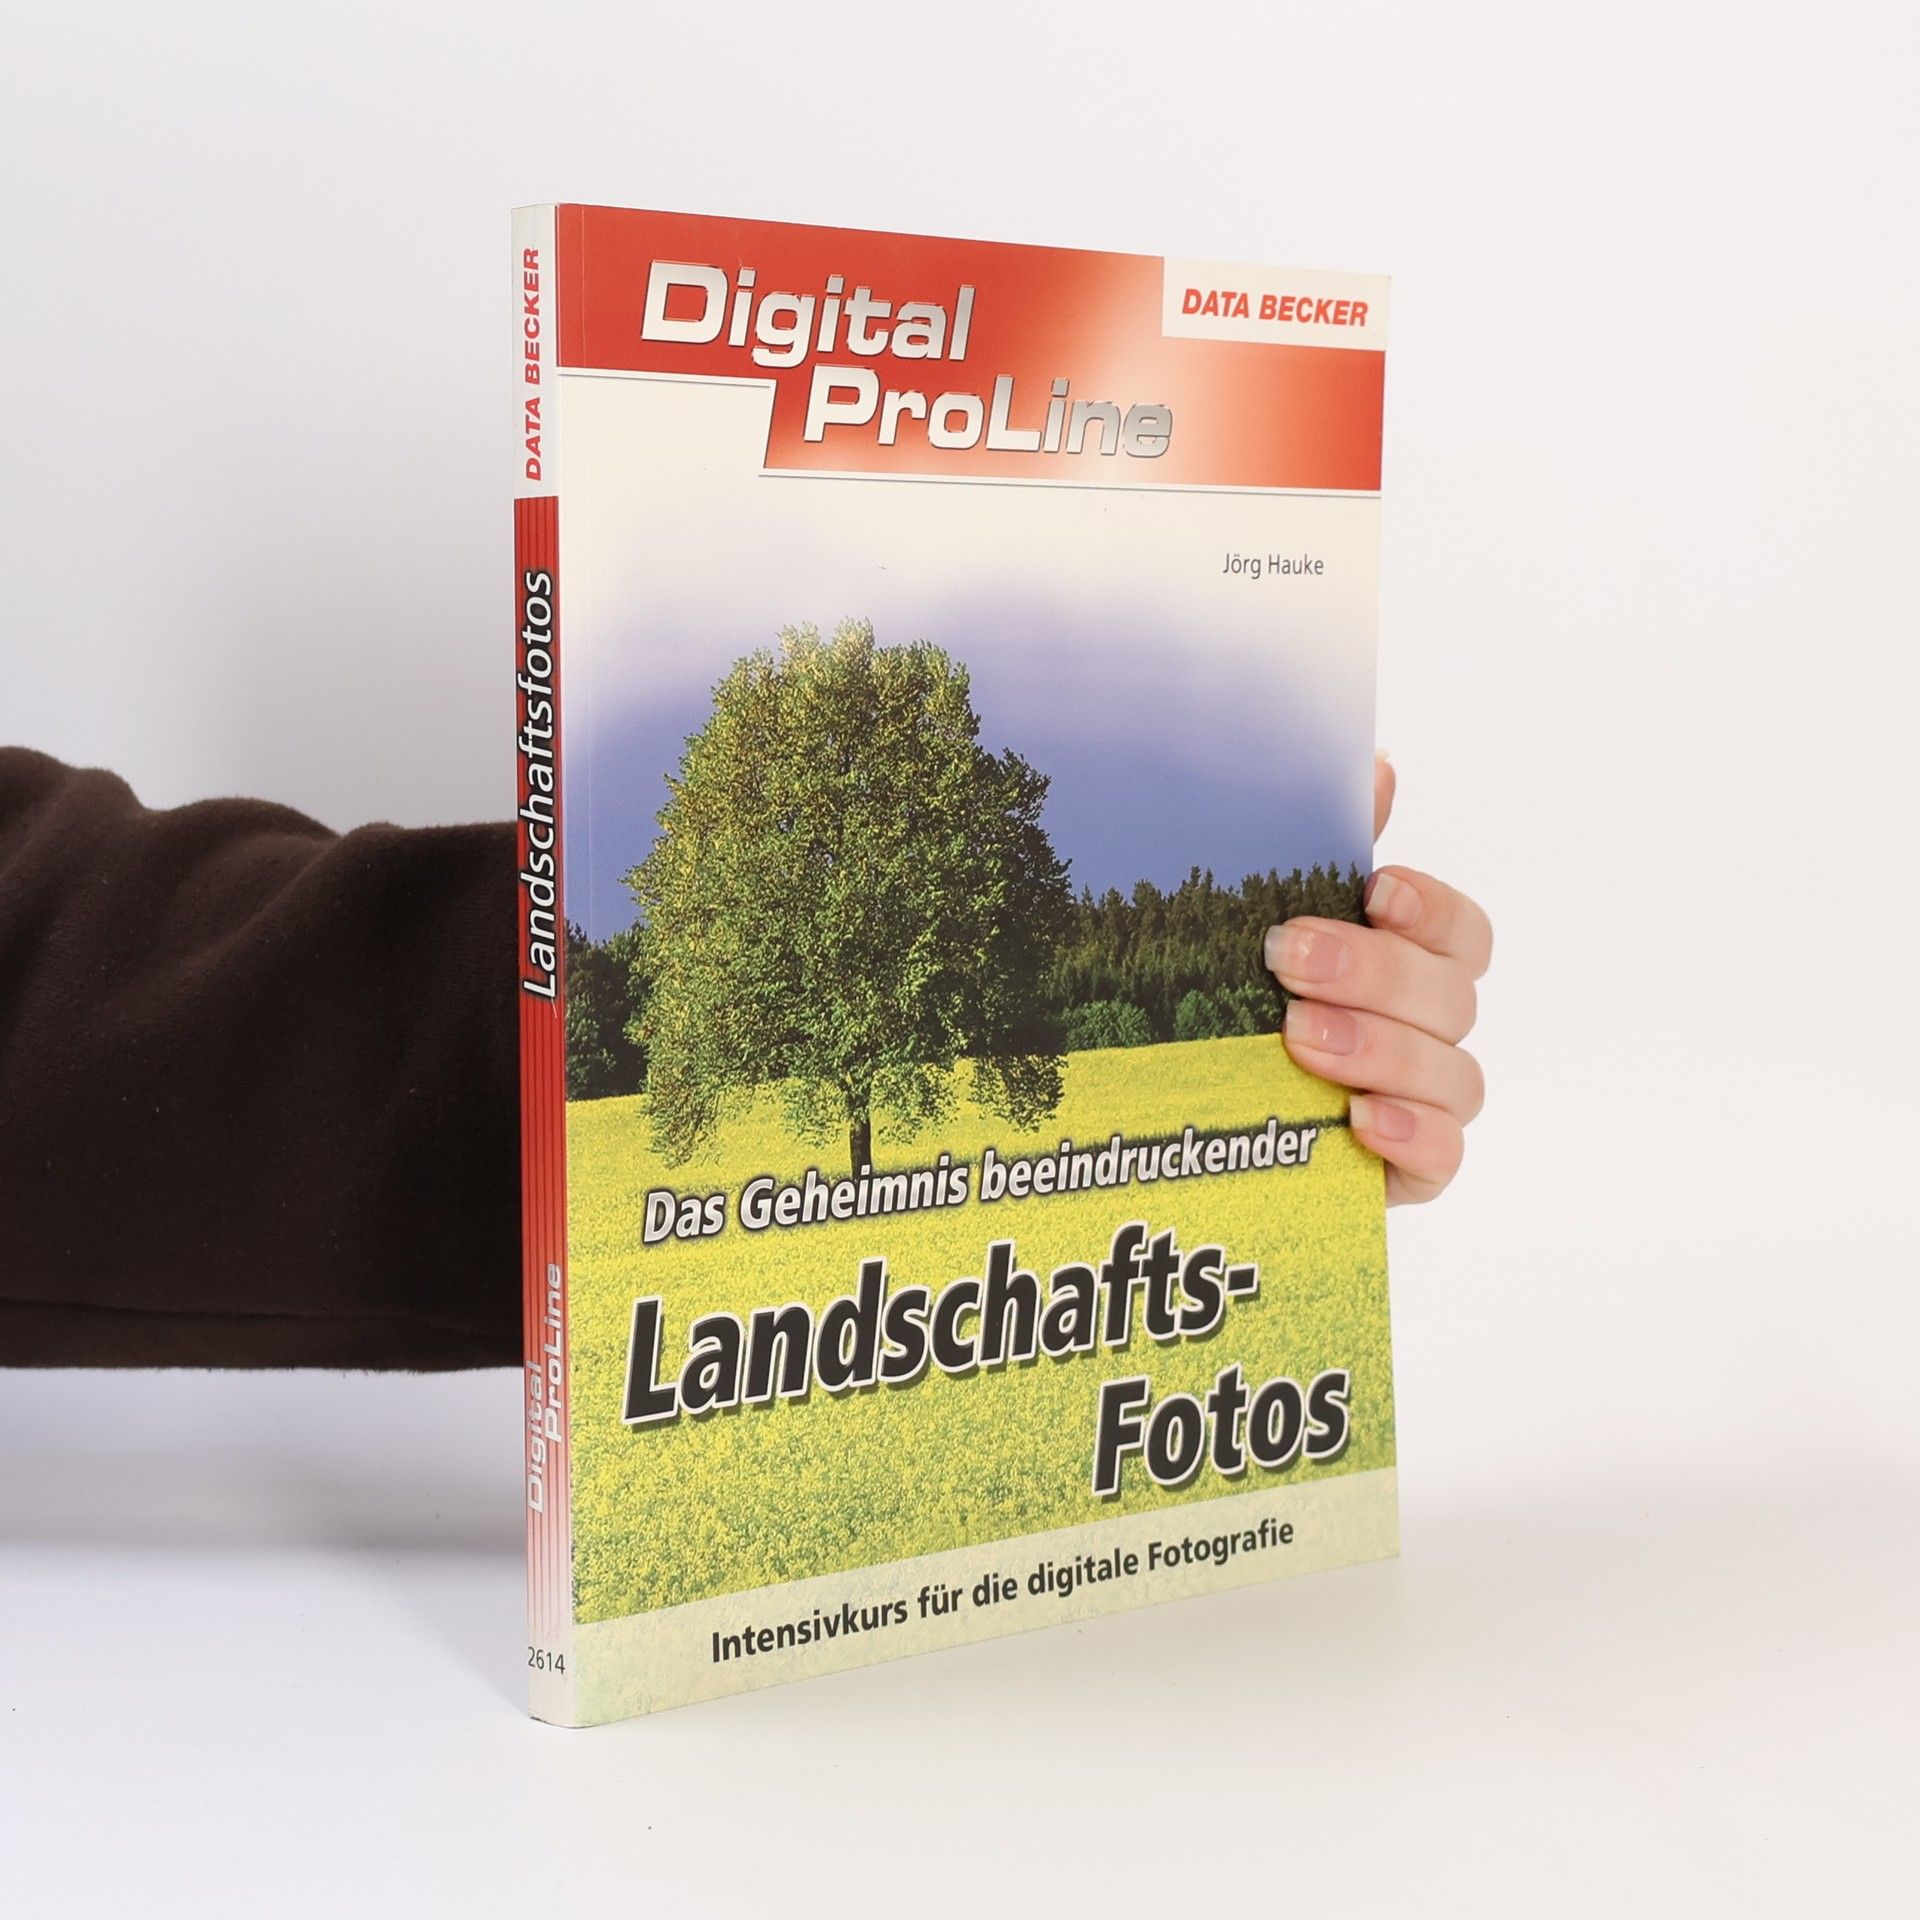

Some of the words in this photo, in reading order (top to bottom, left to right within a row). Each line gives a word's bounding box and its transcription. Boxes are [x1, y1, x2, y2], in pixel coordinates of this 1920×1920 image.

[523, 248, 540, 385] BECKER
[640, 258, 974, 368] Digital
[1182, 287, 1252, 319] DATA
[1257, 293, 1370, 328] BECKER
[524, 396, 541, 481] DATA
[803, 364, 1174, 459] ProLine
[1222, 552, 1261, 579] Jörg
[1267, 553, 1325, 577] Hauke
[517, 570, 557, 1000] Landschaftsfotos
[643, 1190, 723, 1244] Das
[739, 1164, 970, 1229] Geheimnis
[980, 1120, 1318, 1202] beeindruckender
[543, 1262, 563, 1444] ProLine
[622, 1221, 1260, 1426] Landschafts-
[526, 1360, 545, 1514] Digital
[1093, 1364, 1351, 1498] Fotos
[711, 1598, 909, 1663] Intensivkurs
[917, 1584, 967, 1619] für
[971, 1571, 1019, 1608] die
[1028, 1548, 1139, 1602] digitale
[1148, 1518, 1295, 1582] Fotografie
[527, 1646, 566, 1675] 2614
